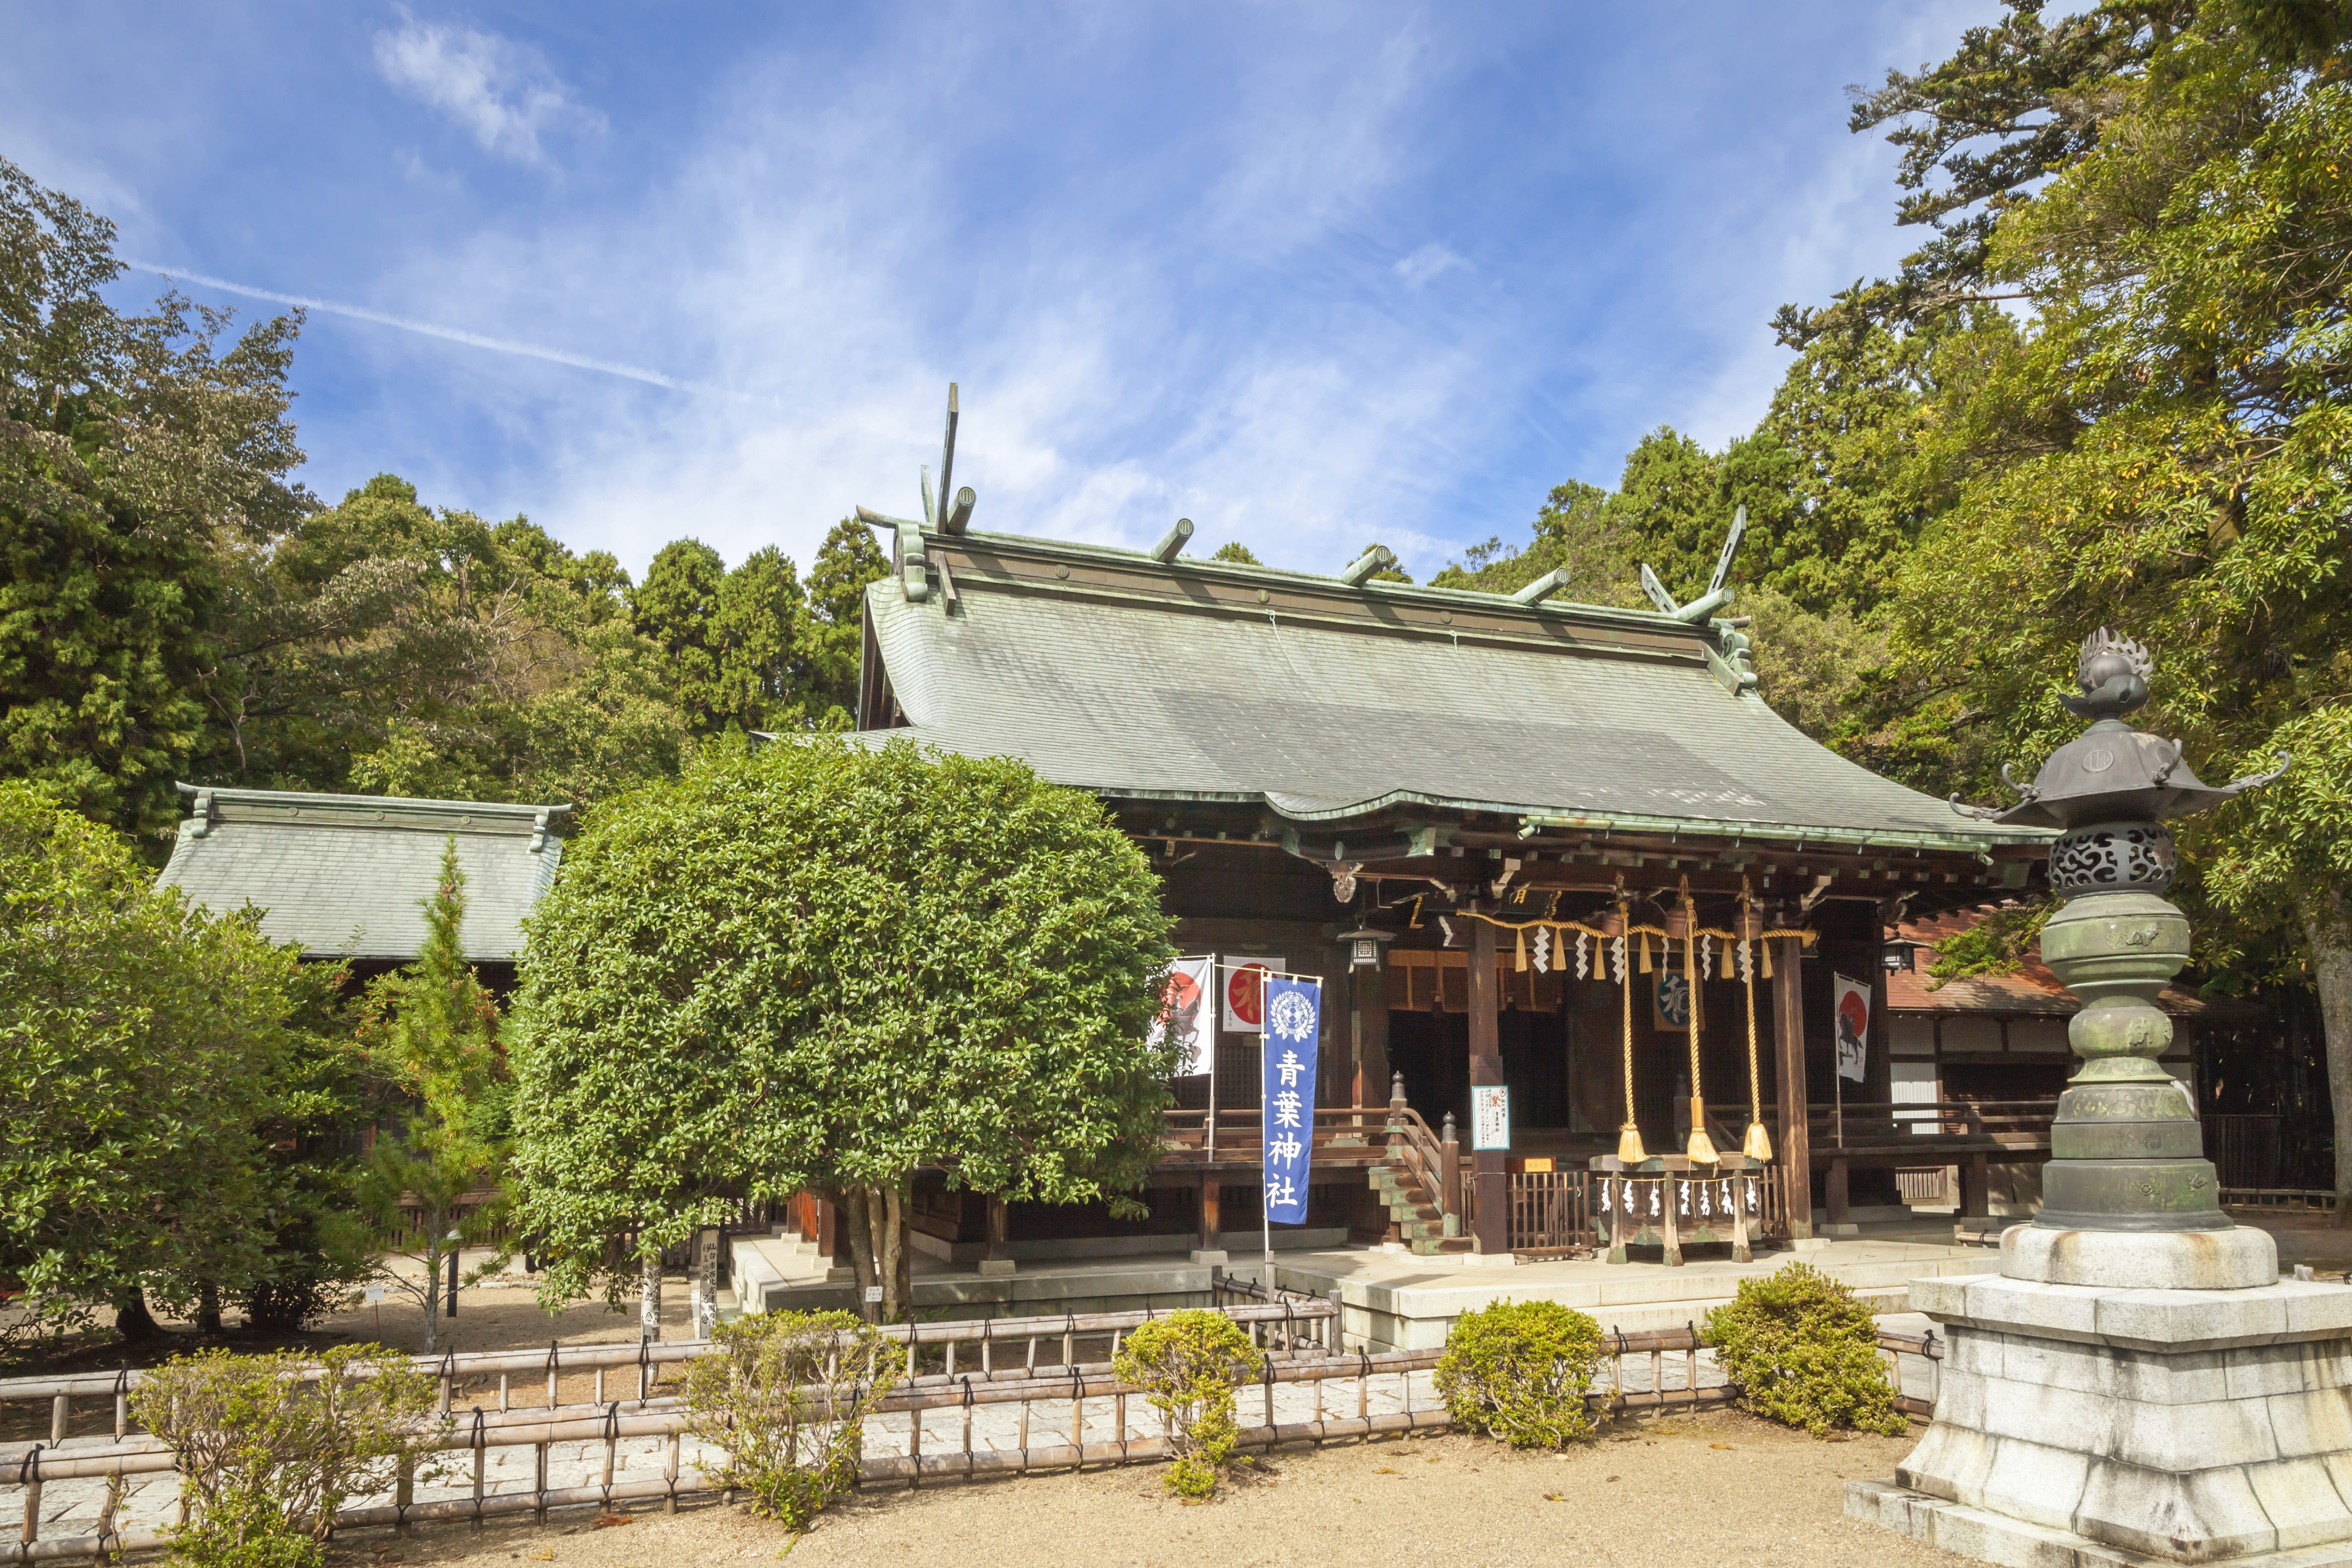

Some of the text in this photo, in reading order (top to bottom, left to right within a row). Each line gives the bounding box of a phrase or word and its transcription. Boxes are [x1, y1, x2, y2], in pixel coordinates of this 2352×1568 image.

[1266, 1050, 1305, 1209] 青葉神社
[701, 1244, 710, 1339] 創立総会記念
